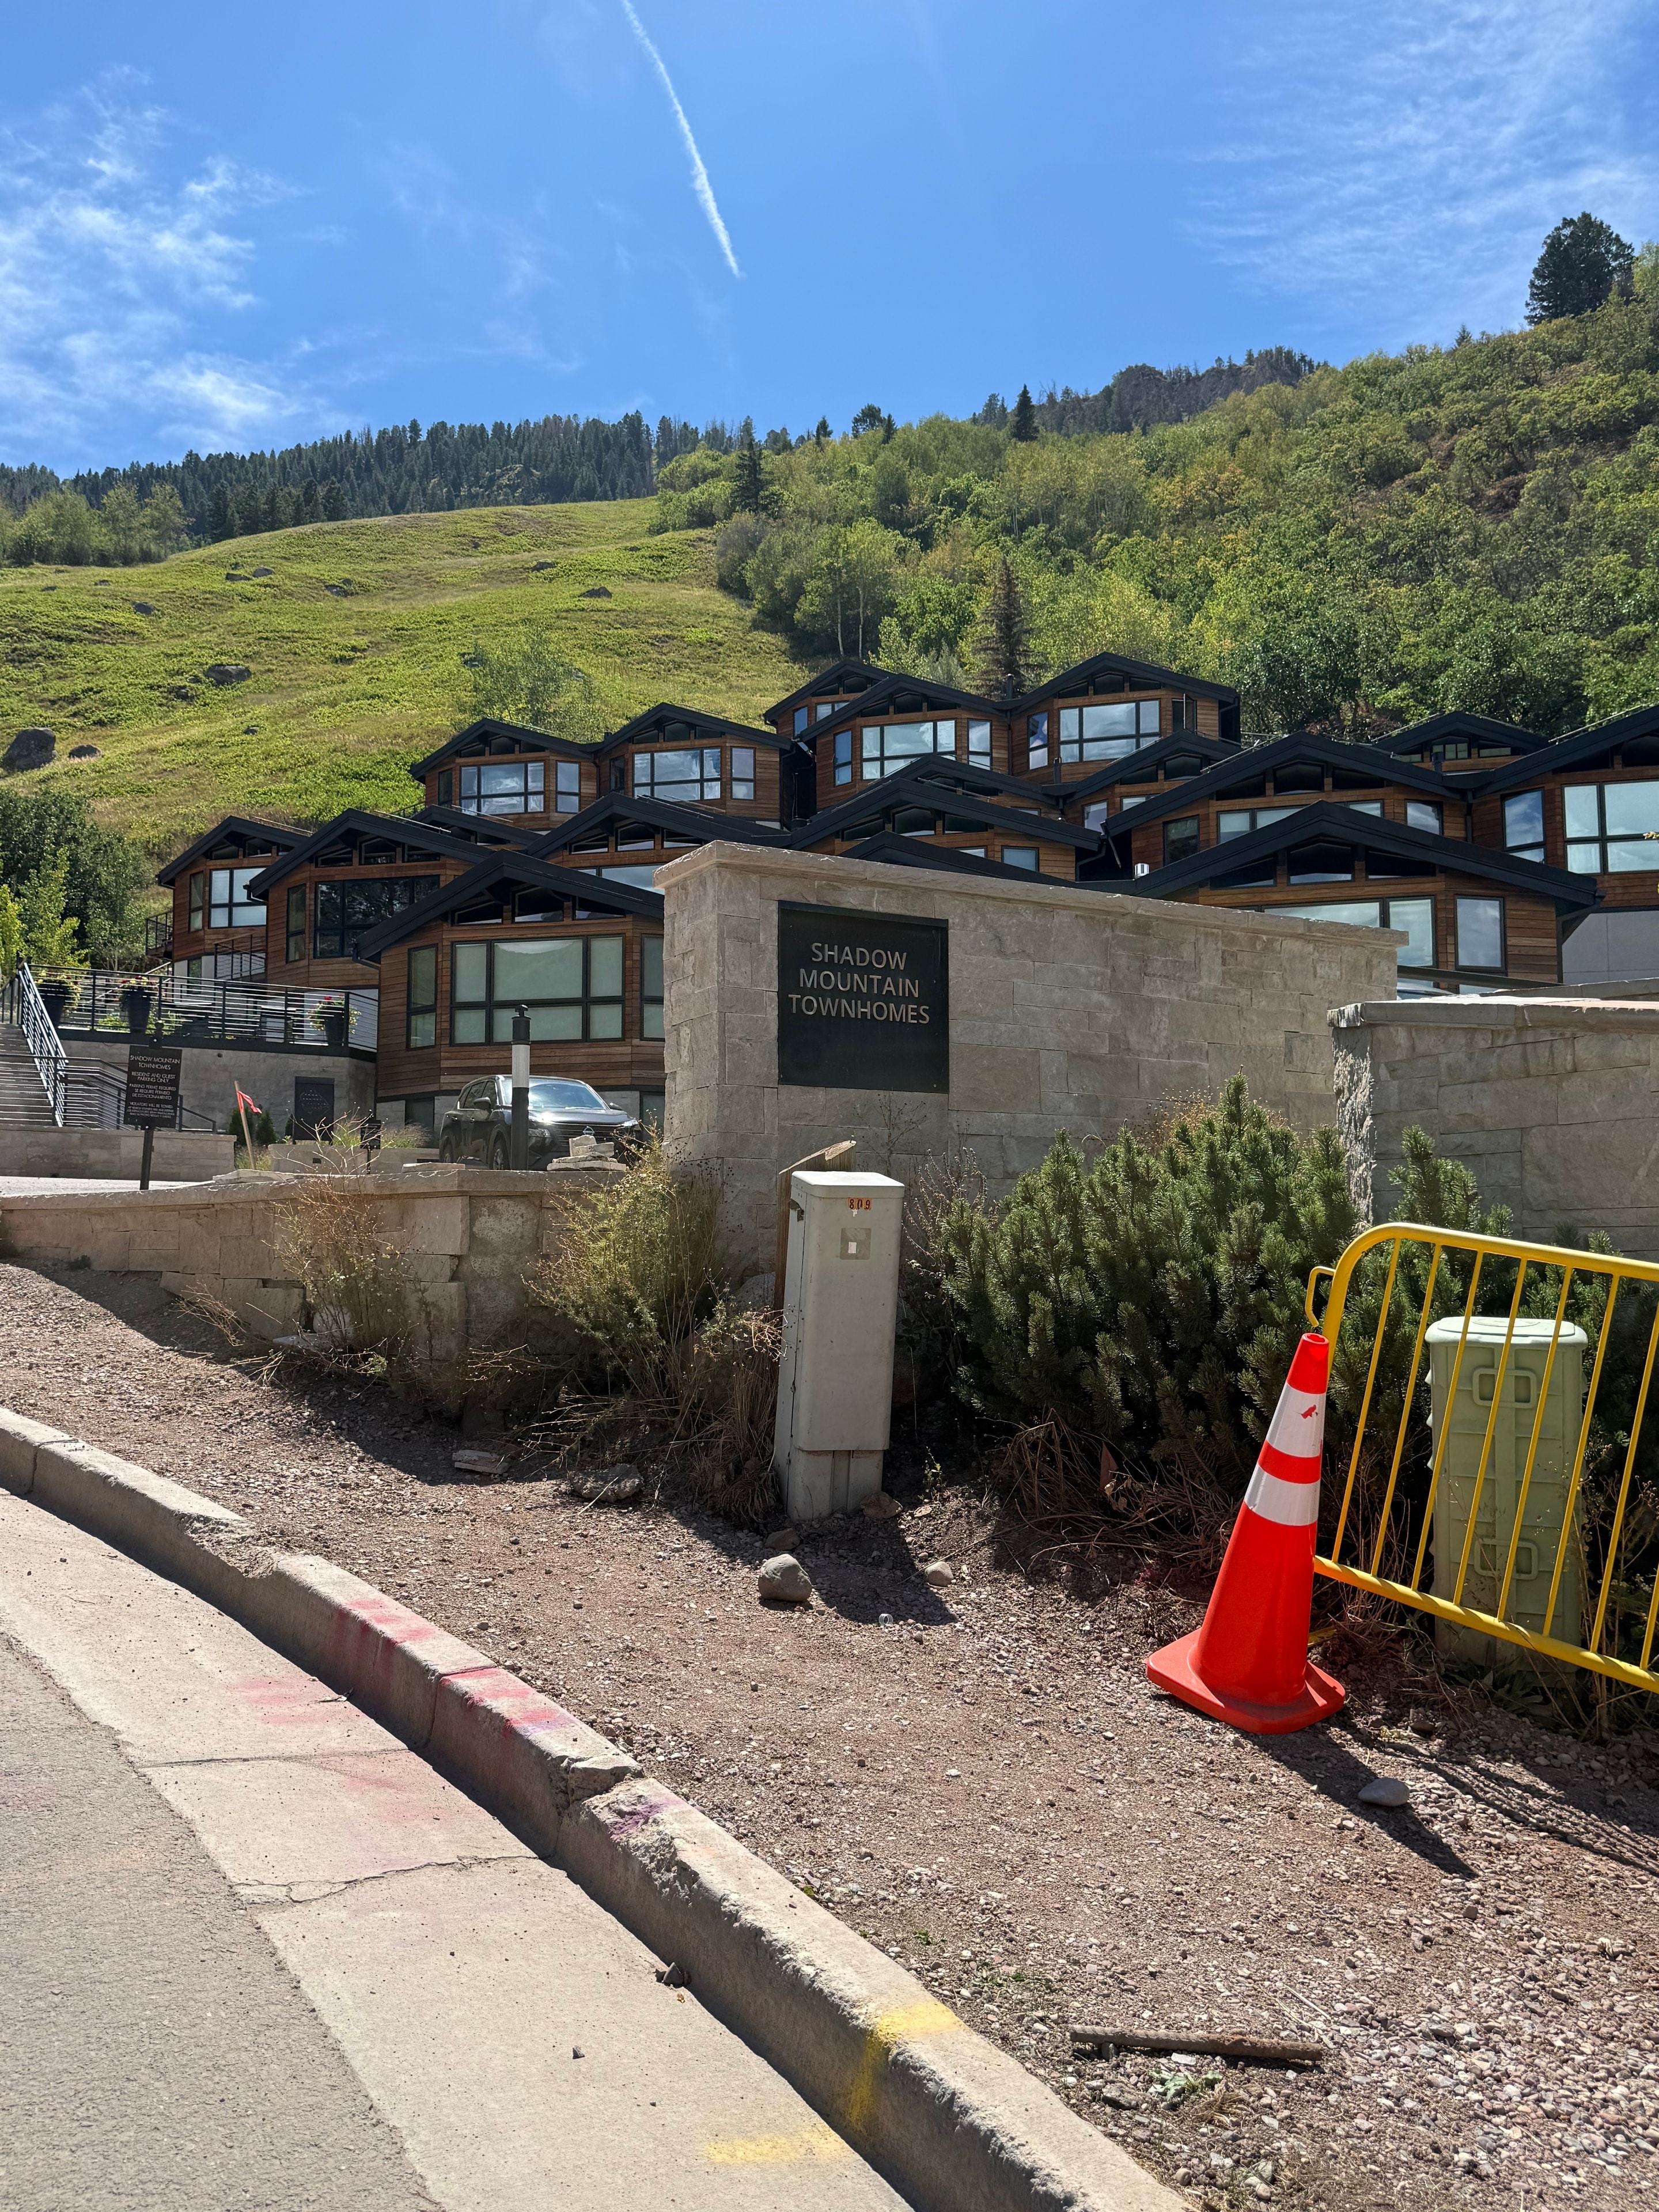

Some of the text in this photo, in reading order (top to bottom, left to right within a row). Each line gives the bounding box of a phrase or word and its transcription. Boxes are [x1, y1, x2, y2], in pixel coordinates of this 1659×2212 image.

[811, 942, 907, 970] SHADOW
[800, 968, 919, 998] MOUNTAIN
[788, 994, 930, 1024] TOWNHOMES
[849, 1199, 870, 1210] 809
